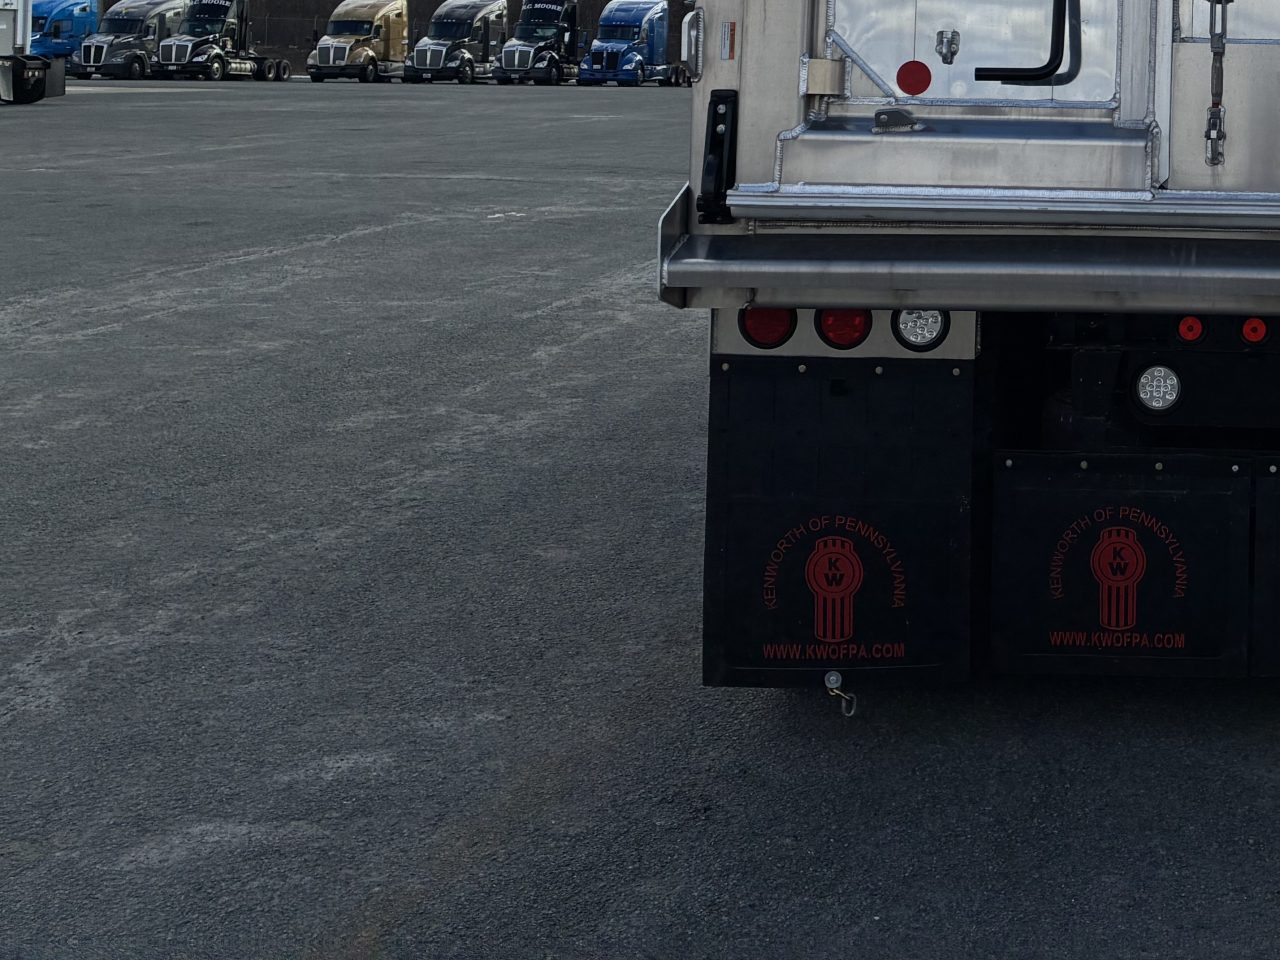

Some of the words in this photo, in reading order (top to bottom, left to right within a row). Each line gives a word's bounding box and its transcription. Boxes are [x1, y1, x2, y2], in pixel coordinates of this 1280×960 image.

[201, 0, 231, 7] MOORE
[534, 3, 563, 12] MOORE
[1050, 516, 1091, 599] KENWORTH
[1094, 507, 1114, 522] OF
[1119, 506, 1189, 598] PENNSYLVANIA
[1112, 546, 1125, 561] K
[763, 523, 807, 609] KENWORTH
[809, 515, 831, 532] OF
[835, 515, 906, 608] PENNSYLVANIA
[828, 557, 841, 572] K
[1108, 561, 1129, 576] W
[824, 573, 845, 587] W
[1050, 631, 1185, 649] WWW.KWOFPA.COM
[763, 643, 905, 659] WWW.KWOFPA.COM
